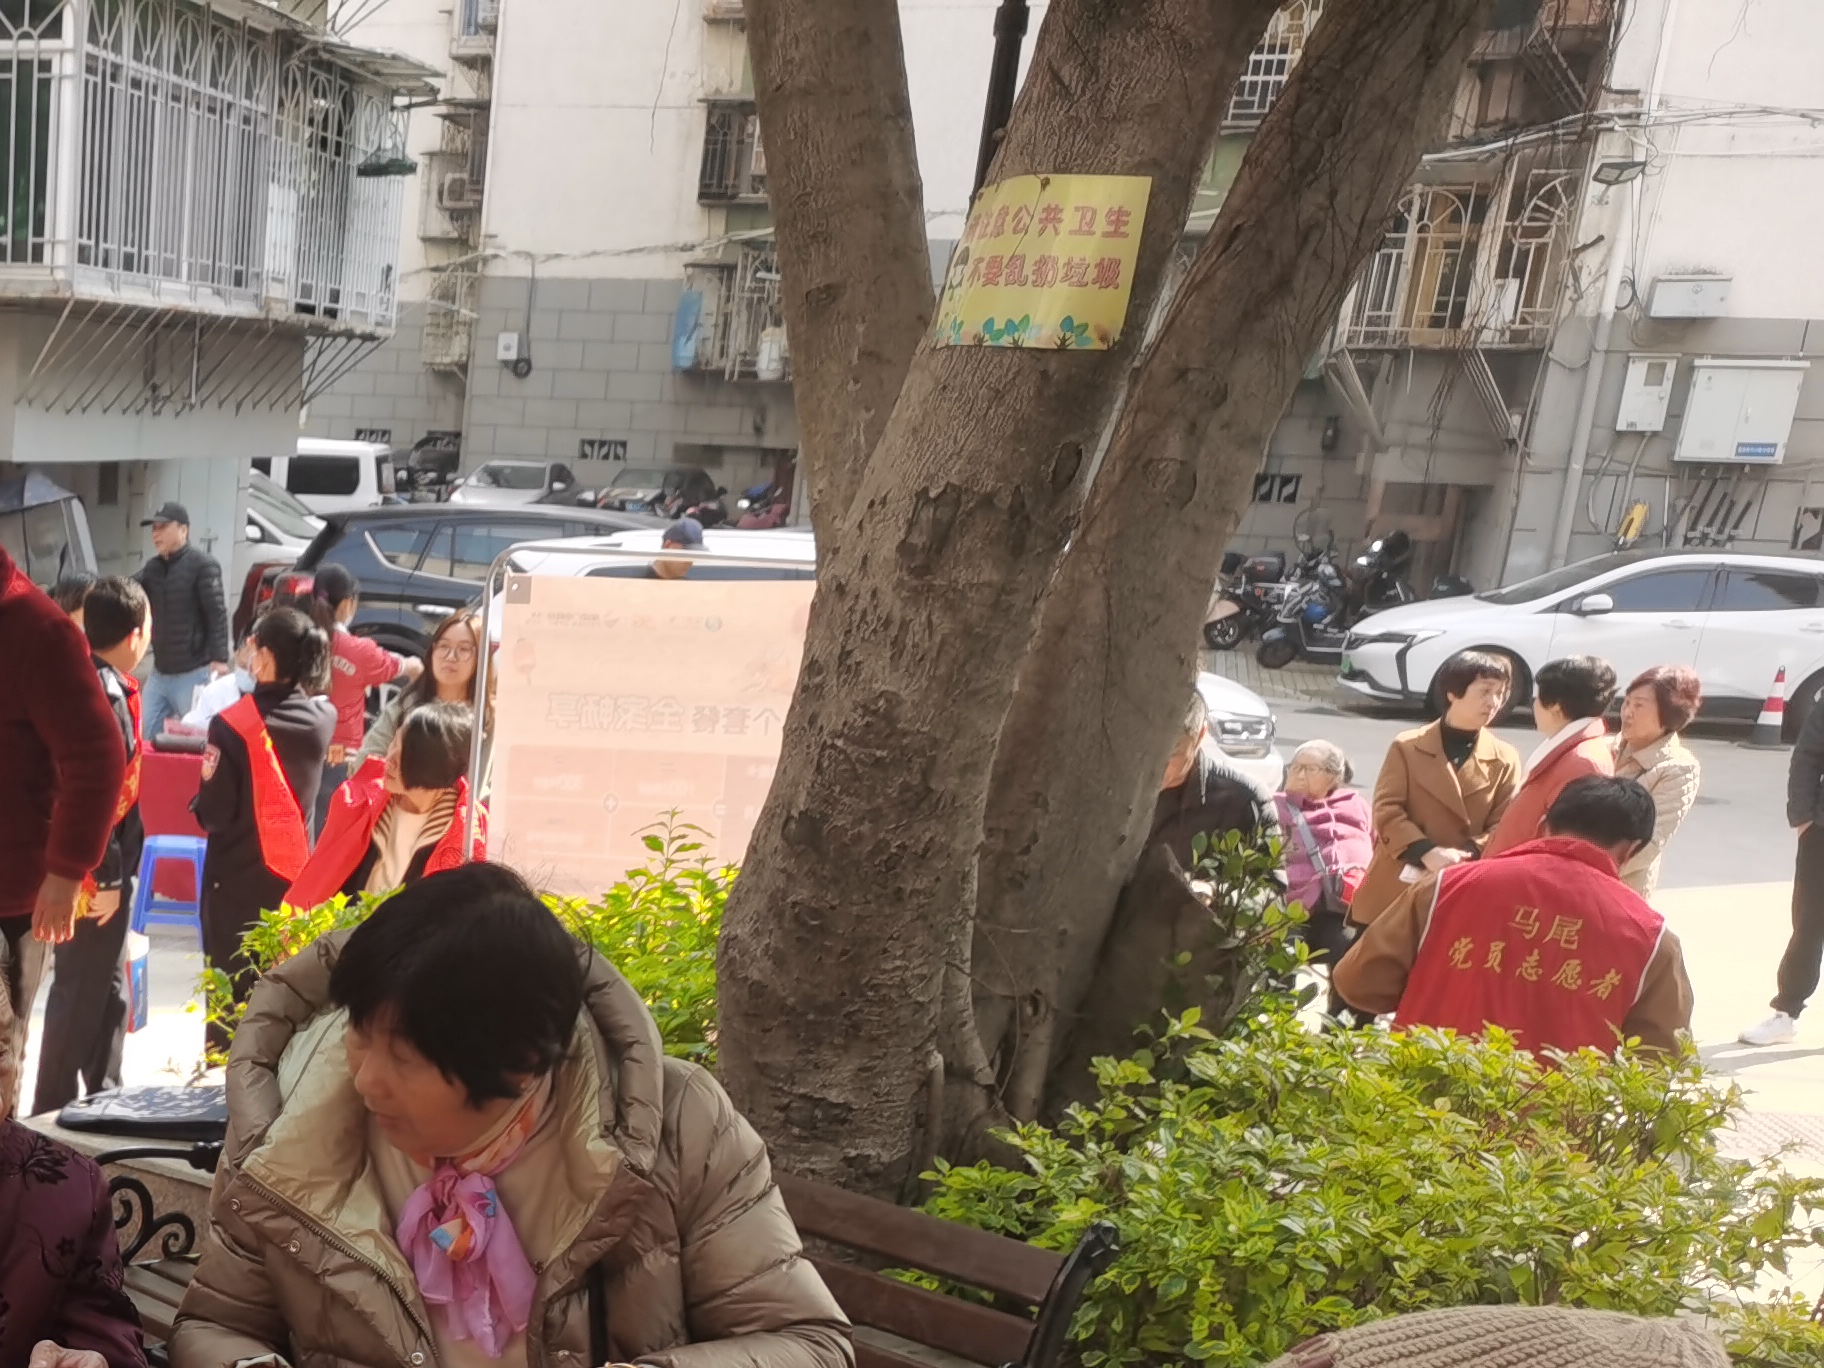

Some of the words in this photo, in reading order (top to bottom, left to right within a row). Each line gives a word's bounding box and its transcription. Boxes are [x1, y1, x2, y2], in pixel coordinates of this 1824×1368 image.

[967, 253, 1122, 290] 不要乱扔垃圾
[1507, 904, 1583, 950] 马尾
[1448, 936, 1623, 1001] 党员志愿者
